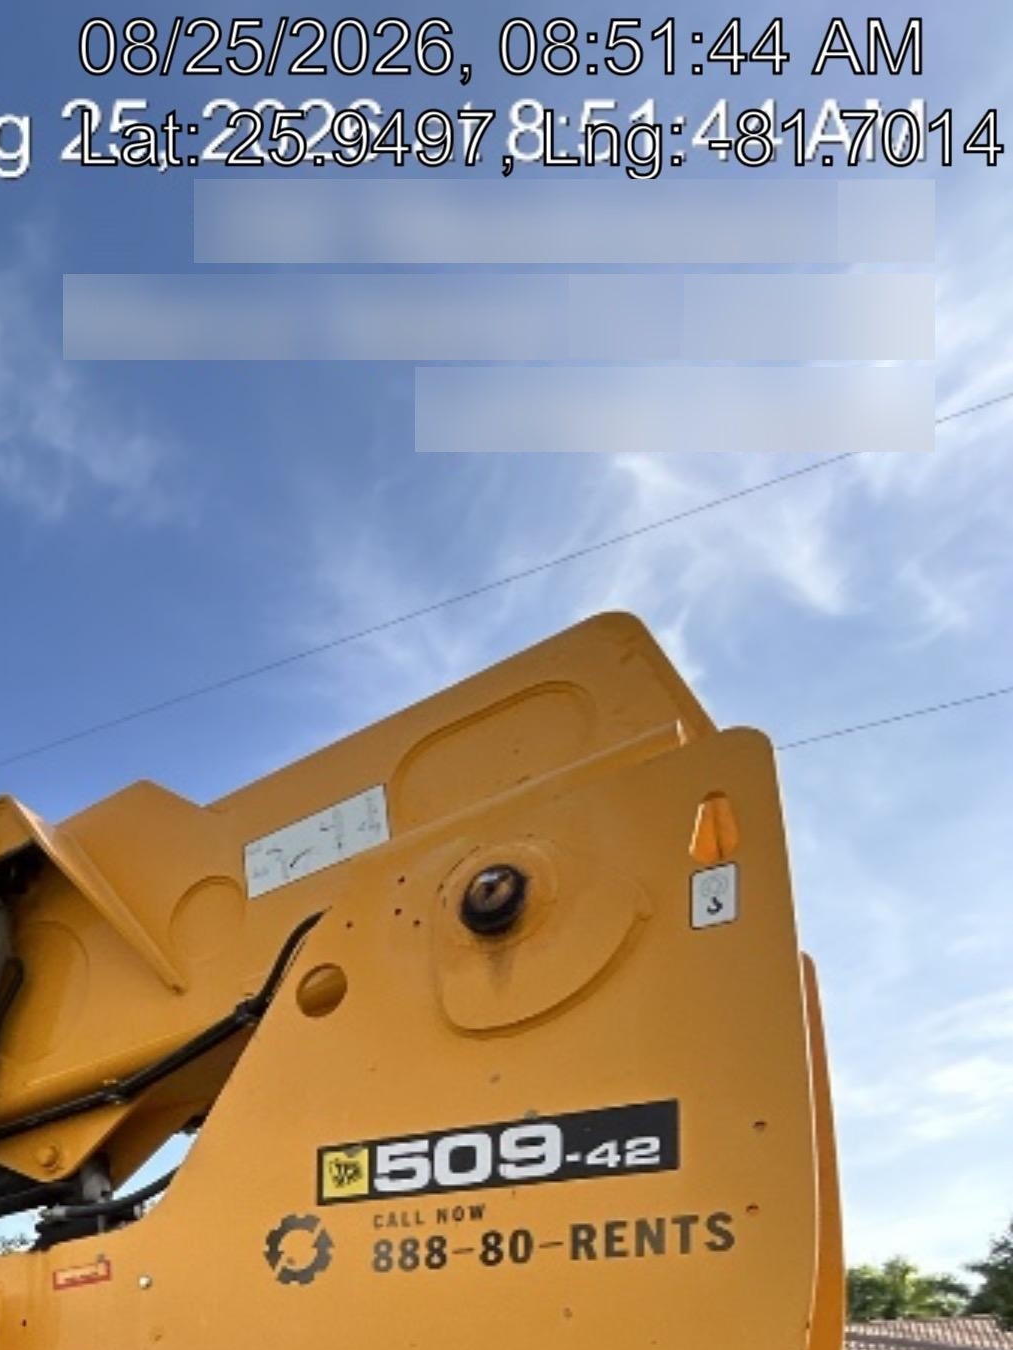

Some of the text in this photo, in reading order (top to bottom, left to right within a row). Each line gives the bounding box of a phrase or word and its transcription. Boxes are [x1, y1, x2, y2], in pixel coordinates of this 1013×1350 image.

[373, 1123, 661, 1193] 509-42
[372, 1212, 736, 1273] 888-80-RENTS
[373, 1203, 486, 1229] CALL NOW
